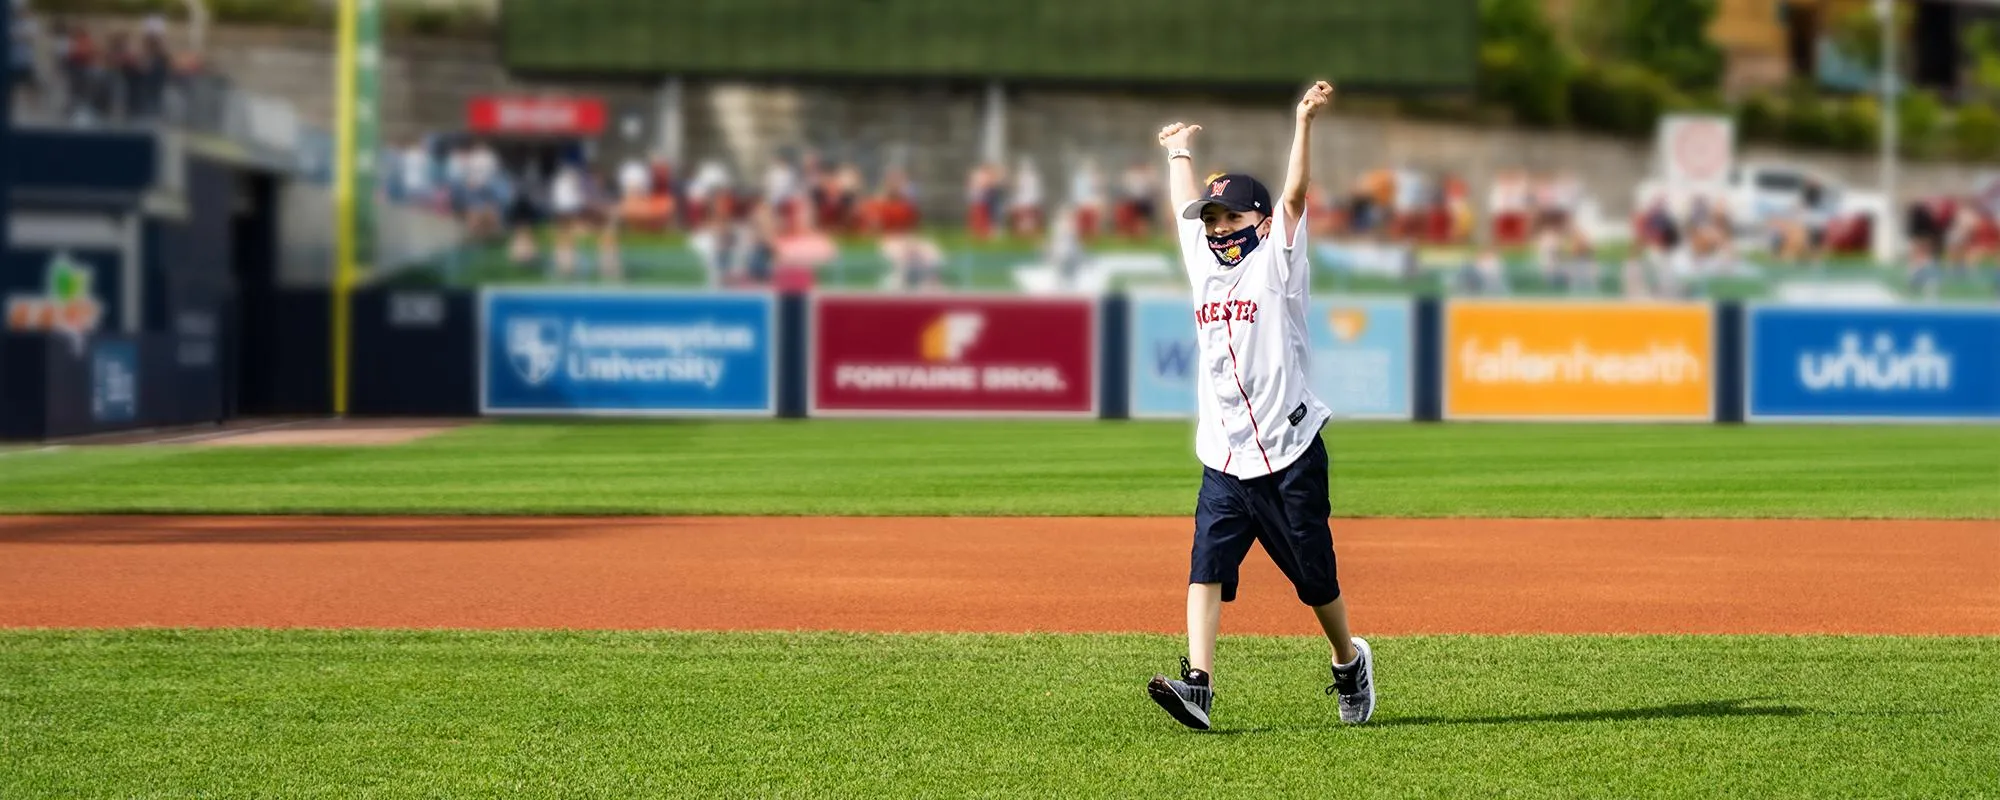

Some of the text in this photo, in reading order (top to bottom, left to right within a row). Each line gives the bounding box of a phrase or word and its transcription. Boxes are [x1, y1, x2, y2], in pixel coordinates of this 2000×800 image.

[1210, 179, 1231, 197] W
[569, 318, 755, 354] Assumption
[566, 352, 724, 388] University
[835, 365, 1067, 391] FONTAINE BROS.
